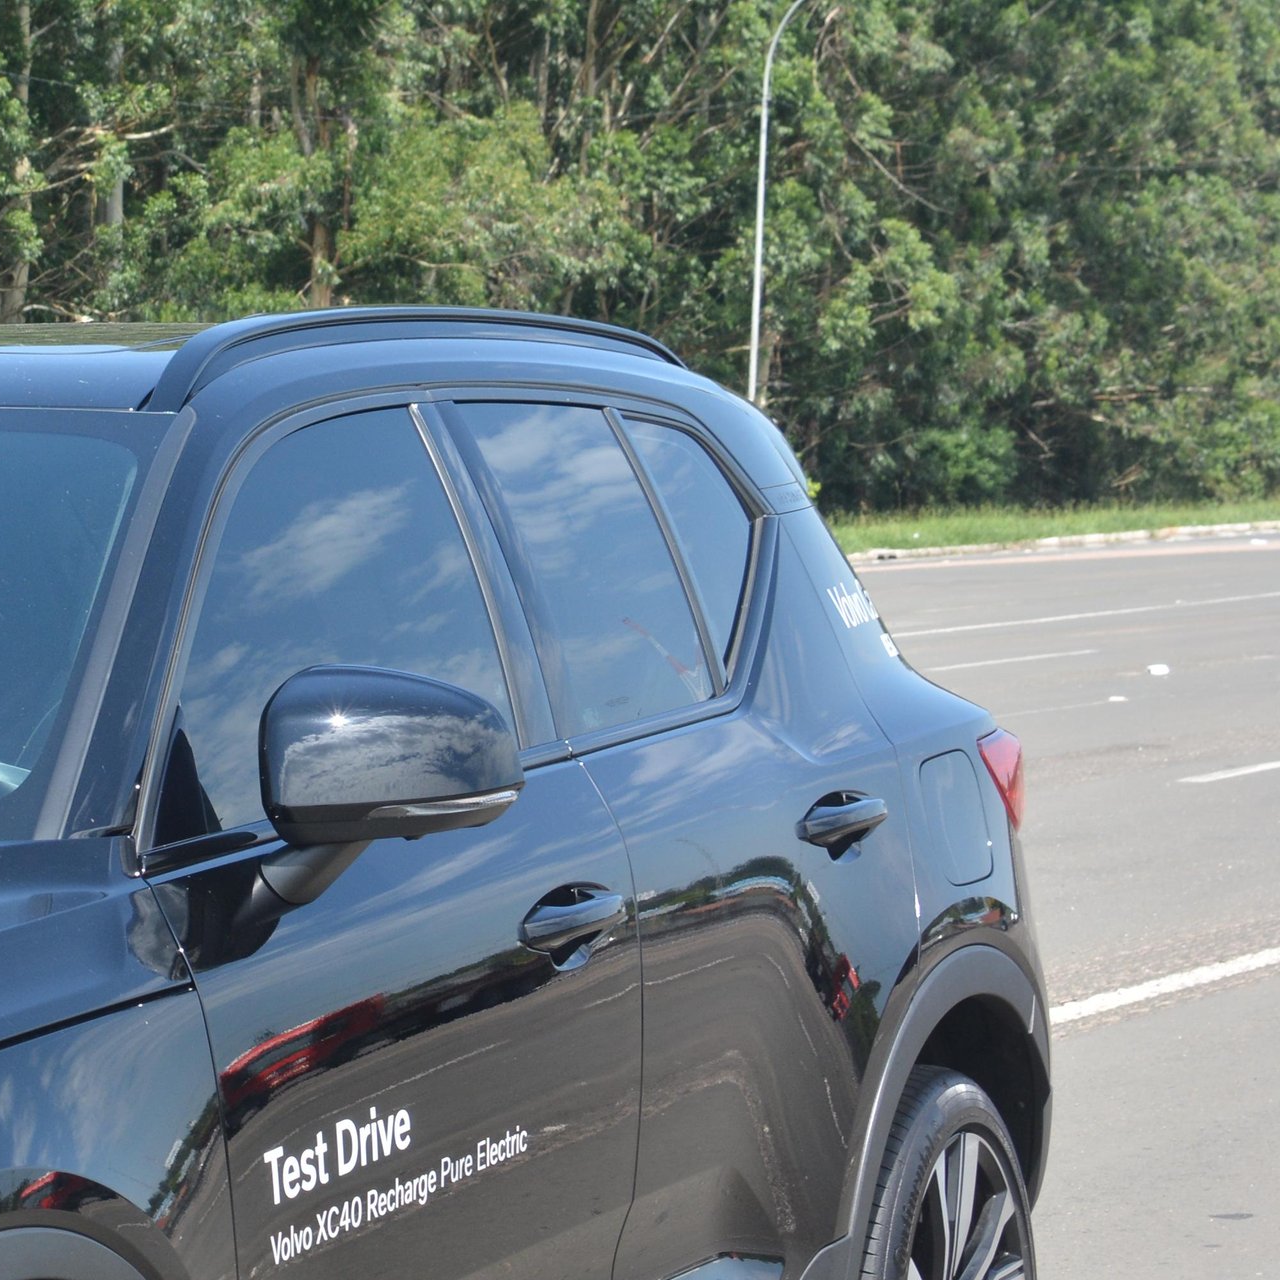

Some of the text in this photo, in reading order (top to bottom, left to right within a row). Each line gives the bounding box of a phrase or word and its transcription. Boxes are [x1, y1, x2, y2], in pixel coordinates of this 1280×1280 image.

[263, 1106, 412, 1205] Test Drive
[269, 1125, 529, 1265] Volvo XC40 Recharge Pure Electric
